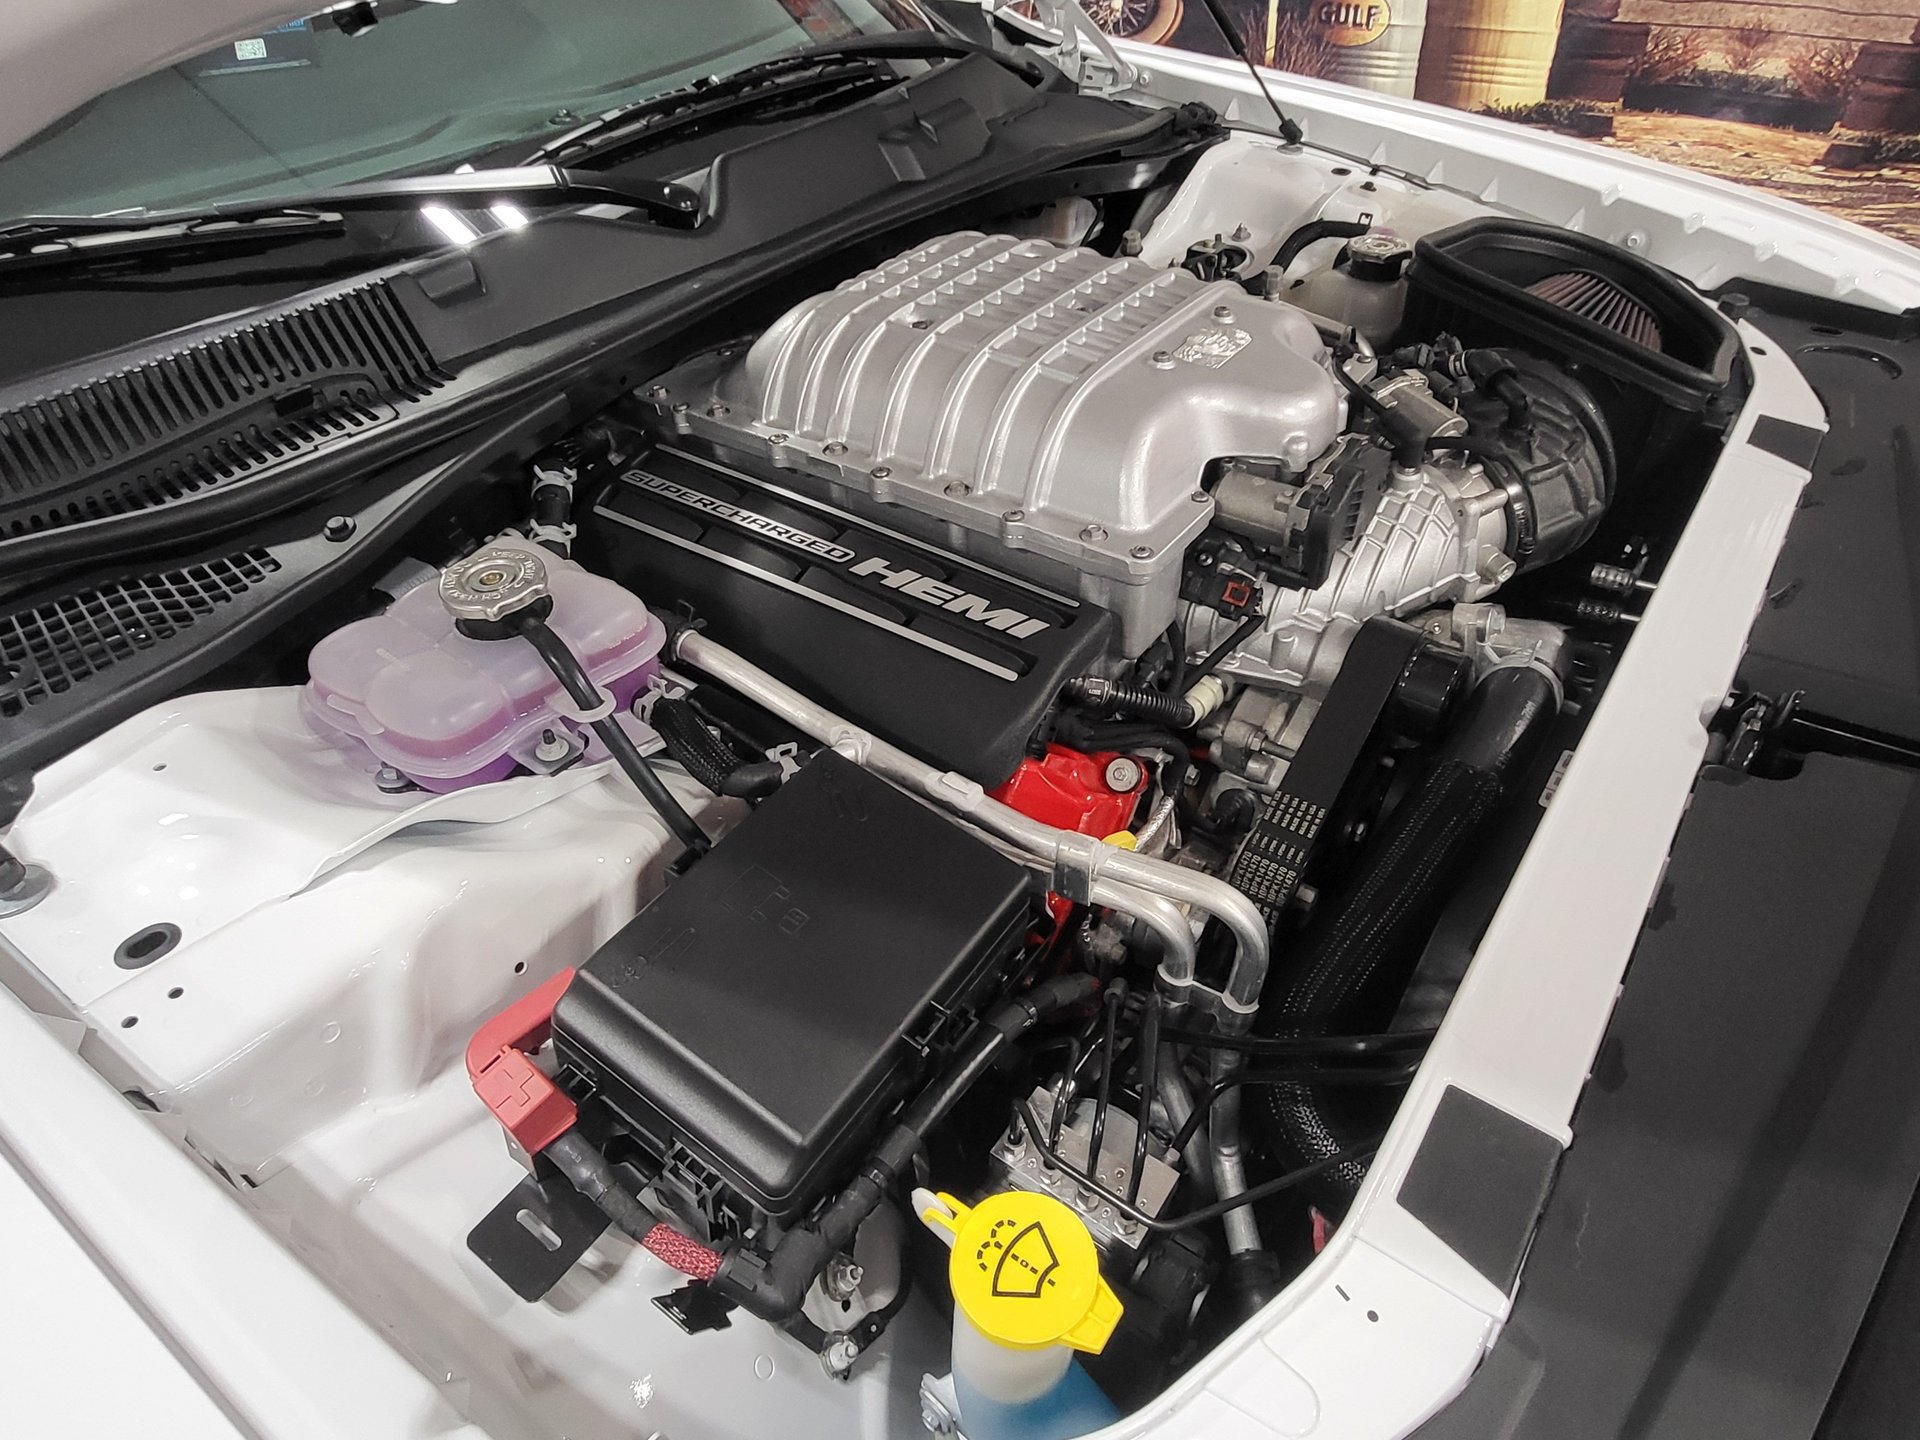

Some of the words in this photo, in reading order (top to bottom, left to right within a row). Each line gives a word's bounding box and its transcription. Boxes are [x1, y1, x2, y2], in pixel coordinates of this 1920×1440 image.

[1319, 3, 1382, 31] GULF
[627, 472, 852, 560] SUPERCHARGED
[848, 556, 1051, 640] HEMI
[1241, 855, 1261, 891] 10PK1470
[1272, 810, 1282, 824] MADE
[1282, 794, 1290, 804] USA
[1249, 859, 1270, 896] 10PK1470
[1281, 813, 1291, 827] MADE
[1291, 798, 1299, 807] USA
[1257, 863, 1278, 899] 10PK1470
[1289, 817, 1300, 831] MADE
[1300, 801, 1308, 811] USA
[1263, 806, 1274, 820] MADE
[1274, 790, 1282, 800] USA
[1307, 824, 1317, 838] MADE
[1317, 808, 1326, 818] USA
[1267, 867, 1287, 903] 10PK1470
[1298, 820, 1308, 835] MADE
[1309, 805, 1317, 814] USA
